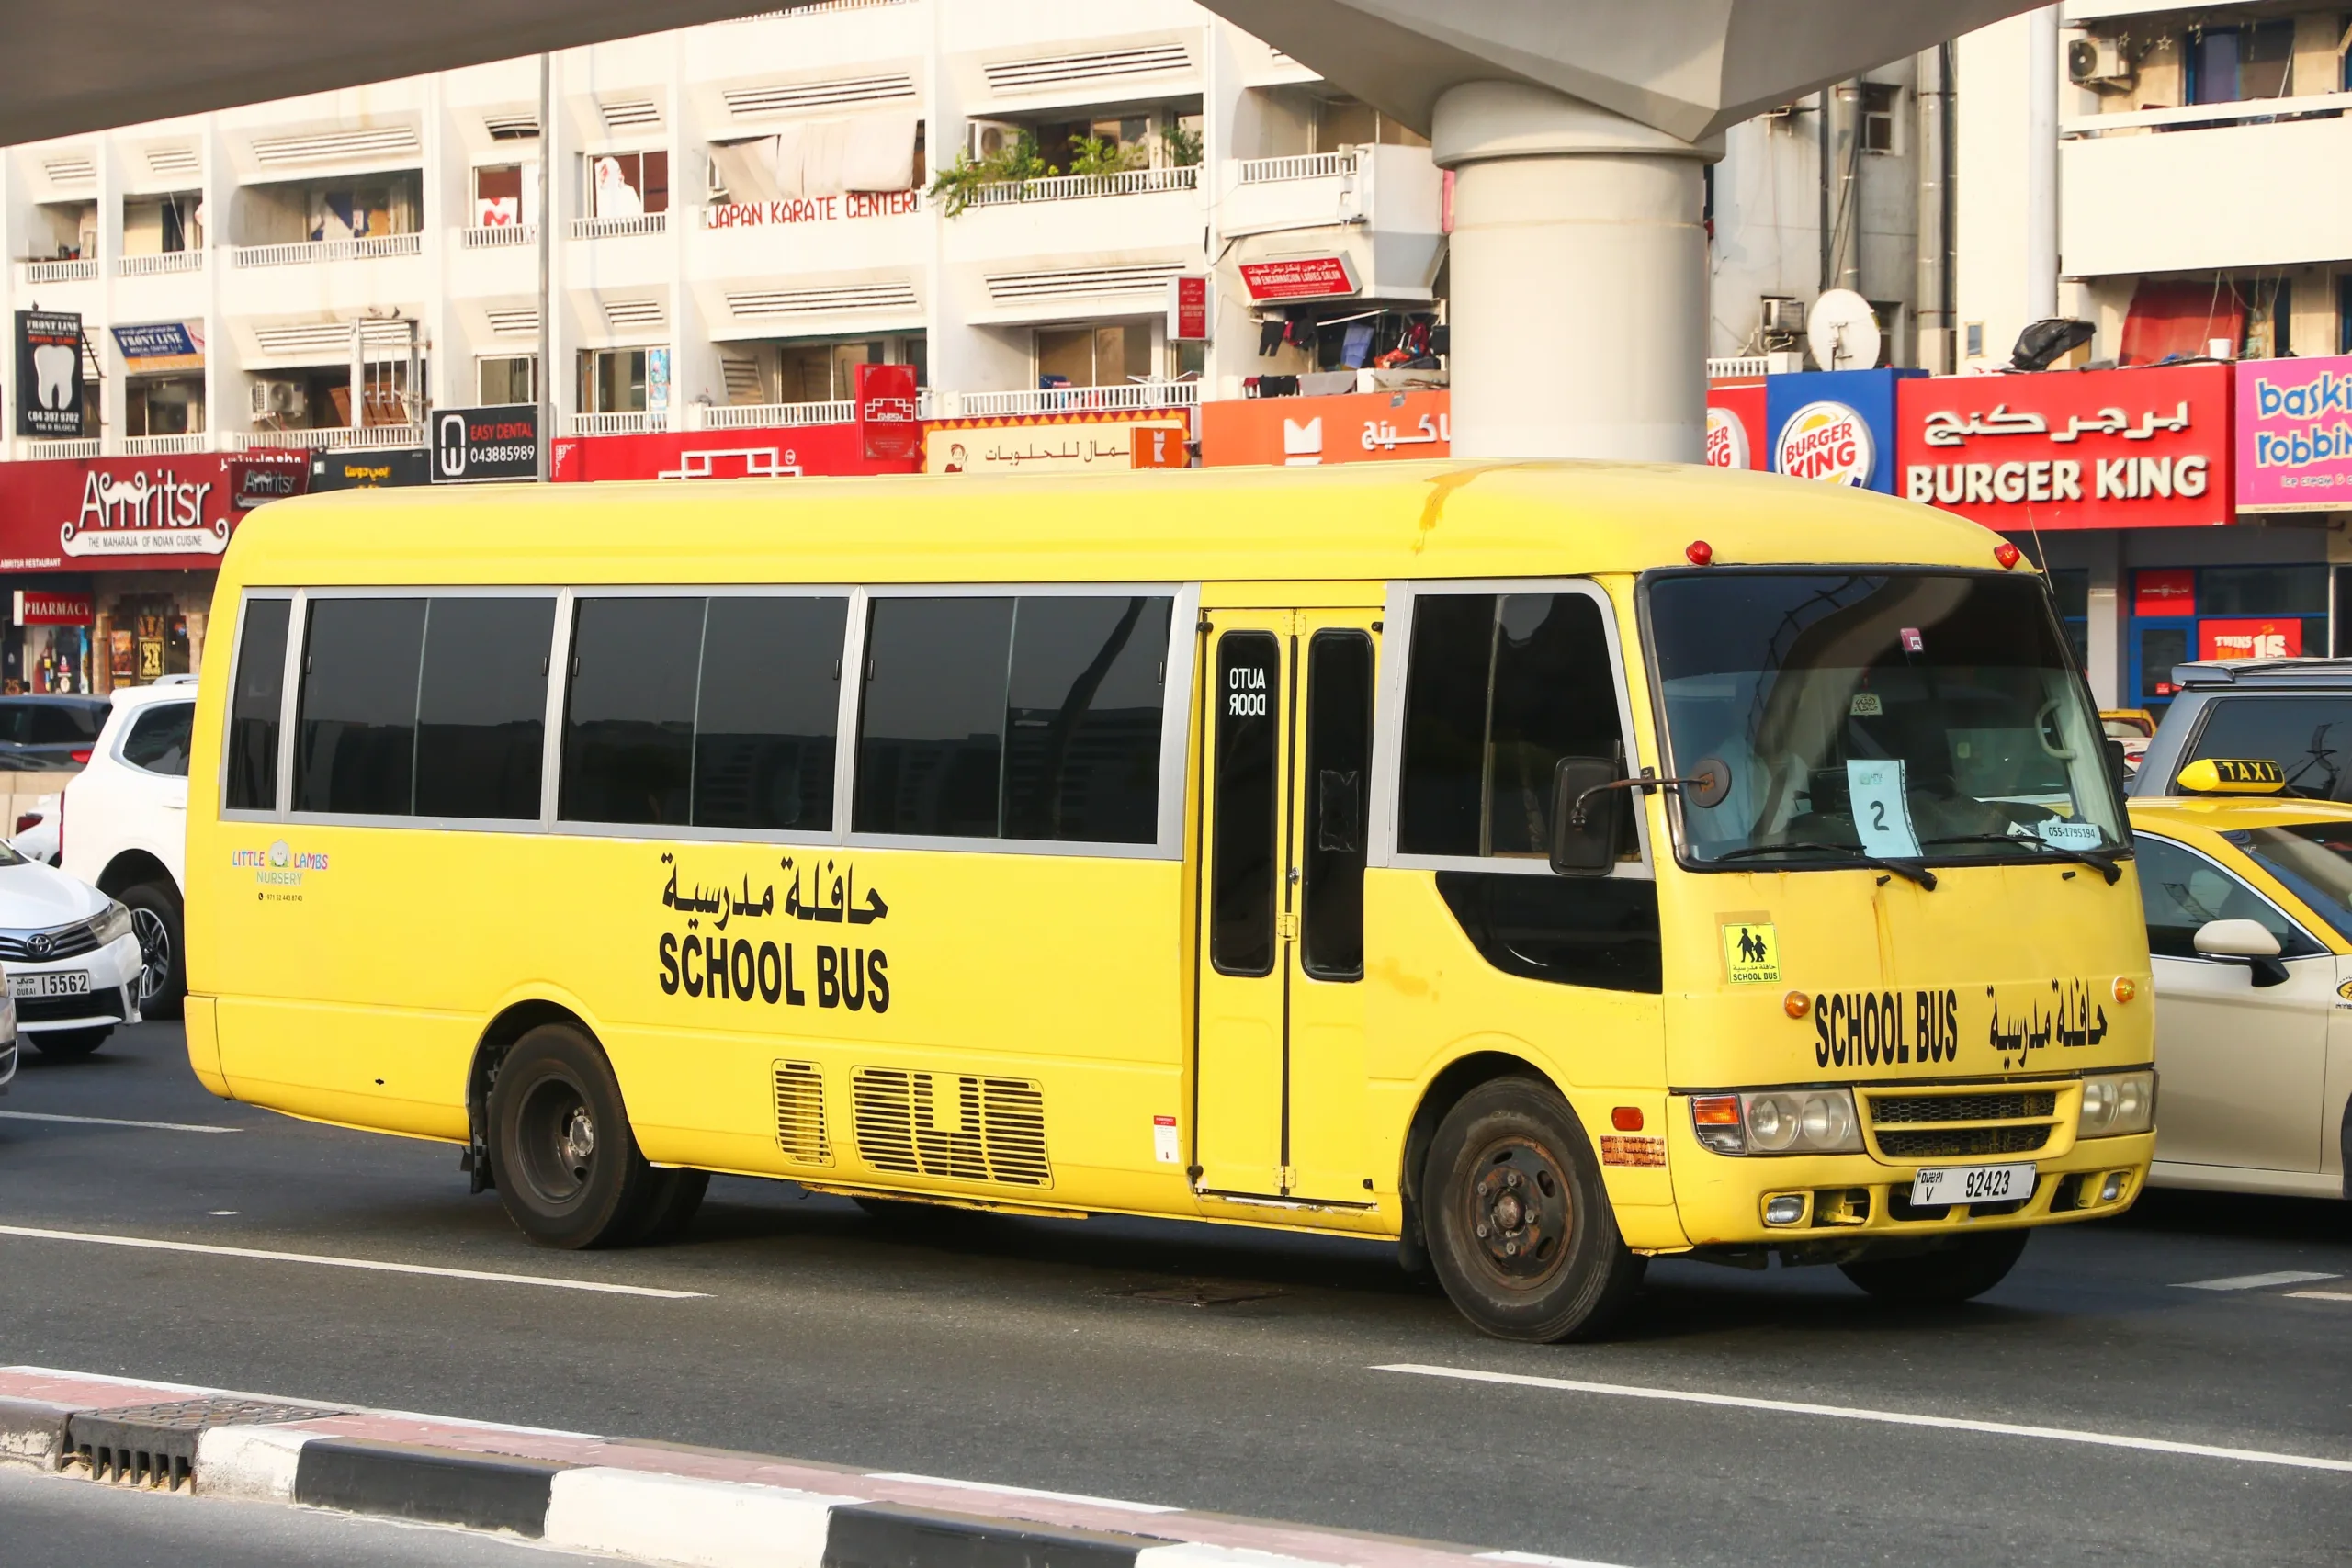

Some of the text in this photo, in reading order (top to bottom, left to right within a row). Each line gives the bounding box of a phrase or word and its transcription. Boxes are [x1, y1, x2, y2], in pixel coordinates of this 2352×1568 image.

[708, 189, 914, 229] JAPAN KARATE CENTER
[1301, 272, 1322, 282] LADIES
[26, 319, 79, 332] FRONT LINE
[120, 333, 182, 347] FRONT LINE
[2256, 373, 2352, 418] baski
[470, 422, 534, 441] EASY DENTAL
[1362, 413, 1451, 450] اكينج
[1924, 400, 2192, 446] برجر كنج
[1707, 426, 1728, 450] GER
[1786, 423, 1853, 465] BURGER
[2256, 425, 2352, 466] robbi
[470, 445, 536, 463] 043885989
[985, 440, 1130, 466] مال للحلويات
[1707, 443, 1731, 467] NG
[1790, 440, 1856, 479] KING
[243, 469, 296, 494] Amritsr
[1906, 455, 2210, 504] BURGER KING
[78, 468, 211, 528] Amritsr
[88, 535, 202, 548] THE MAHARAJA OF INDIAN CUISINE
[0, 558, 62, 569] AMRITSR RESTAURANT
[24, 601, 90, 616] PHARMACY
[142, 643, 161, 653] OPEN
[2214, 636, 2252, 649] TWINS
[144, 652, 160, 669] 24
[2222, 761, 2275, 781] TAXI
[1870, 800, 1889, 831] 2
[2048, 827, 2096, 838] 055-1795194
[232, 851, 329, 870] LITTLE LAMBS
[256, 872, 303, 885] NURSERY
[660, 852, 889, 931] حافلة مدرسية
[659, 932, 890, 1014] SCHOOL BUS
[1733, 972, 1778, 981] SCHOOL BUS
[17, 987, 37, 996] DUBAI
[1815, 988, 1958, 1068] SCHOOL BUS
[1986, 976, 2108, 1071] حافلة مدرسية
[1926, 1187, 1934, 1201] V
[1965, 1170, 2011, 1198] 92423
